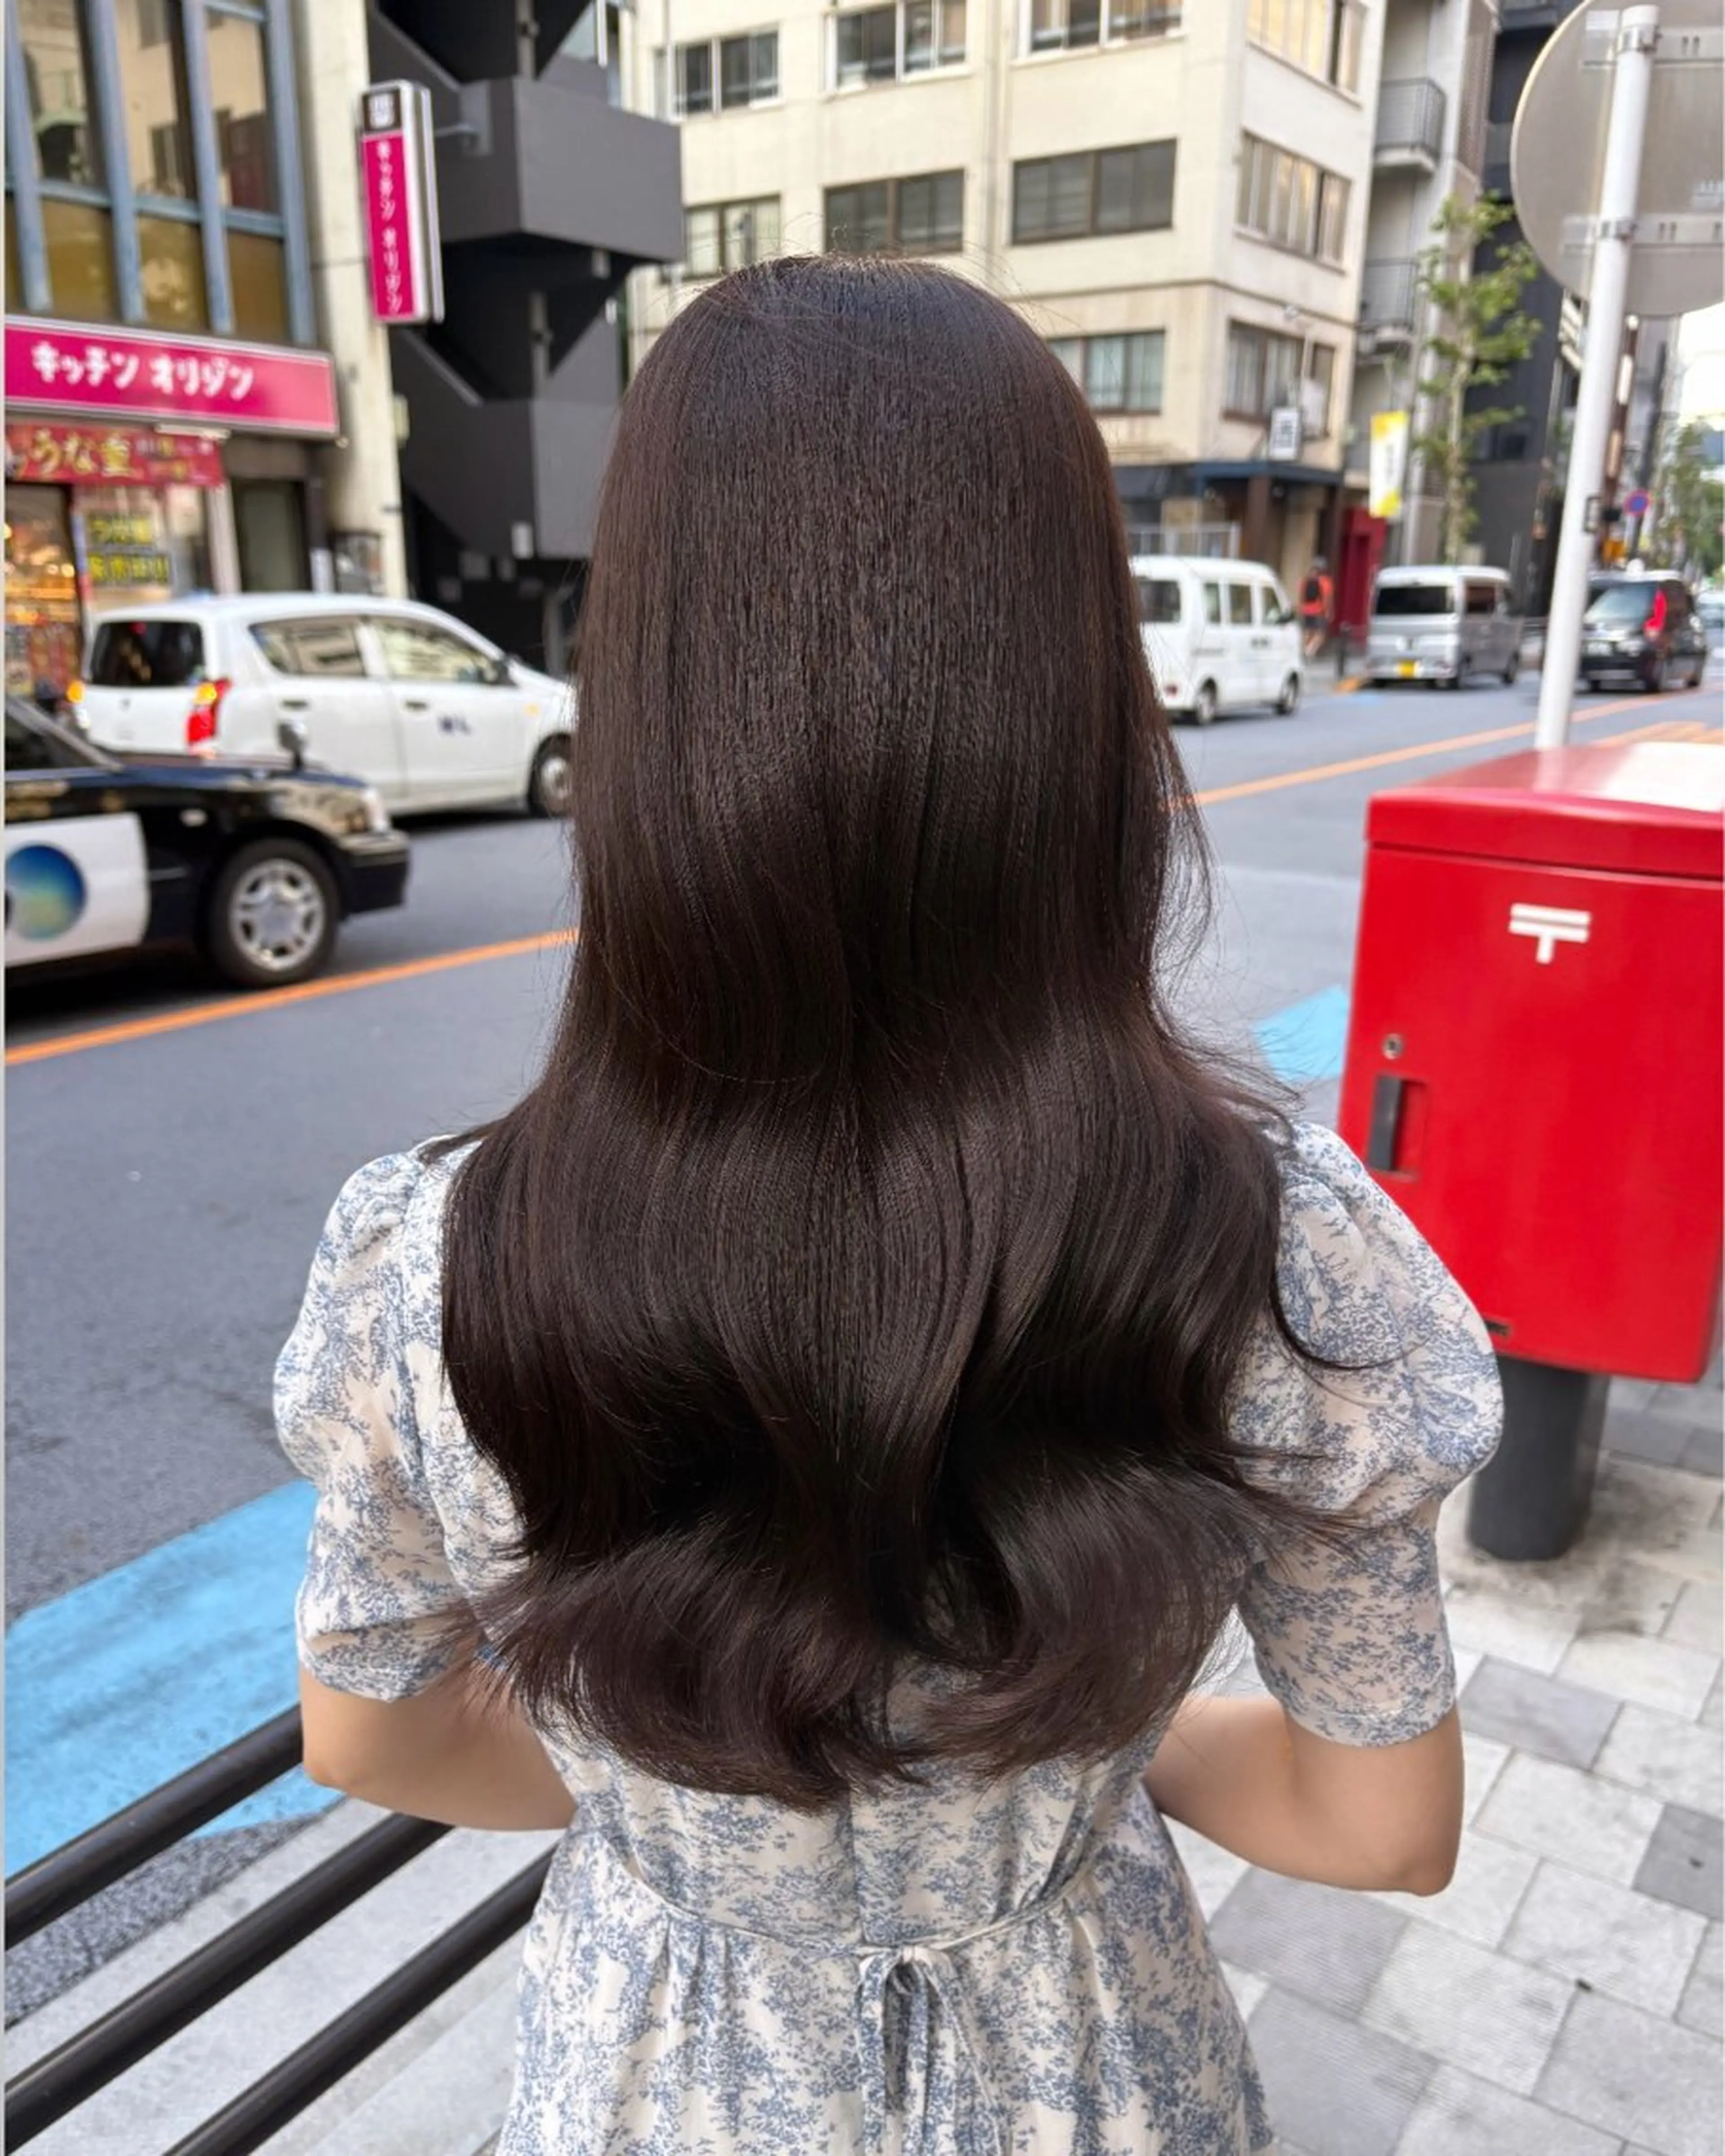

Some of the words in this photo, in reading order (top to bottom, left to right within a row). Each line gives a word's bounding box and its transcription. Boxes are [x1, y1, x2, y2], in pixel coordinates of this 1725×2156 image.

[31, 340, 139, 390] キッチン
[149, 353, 254, 401] オリジン
